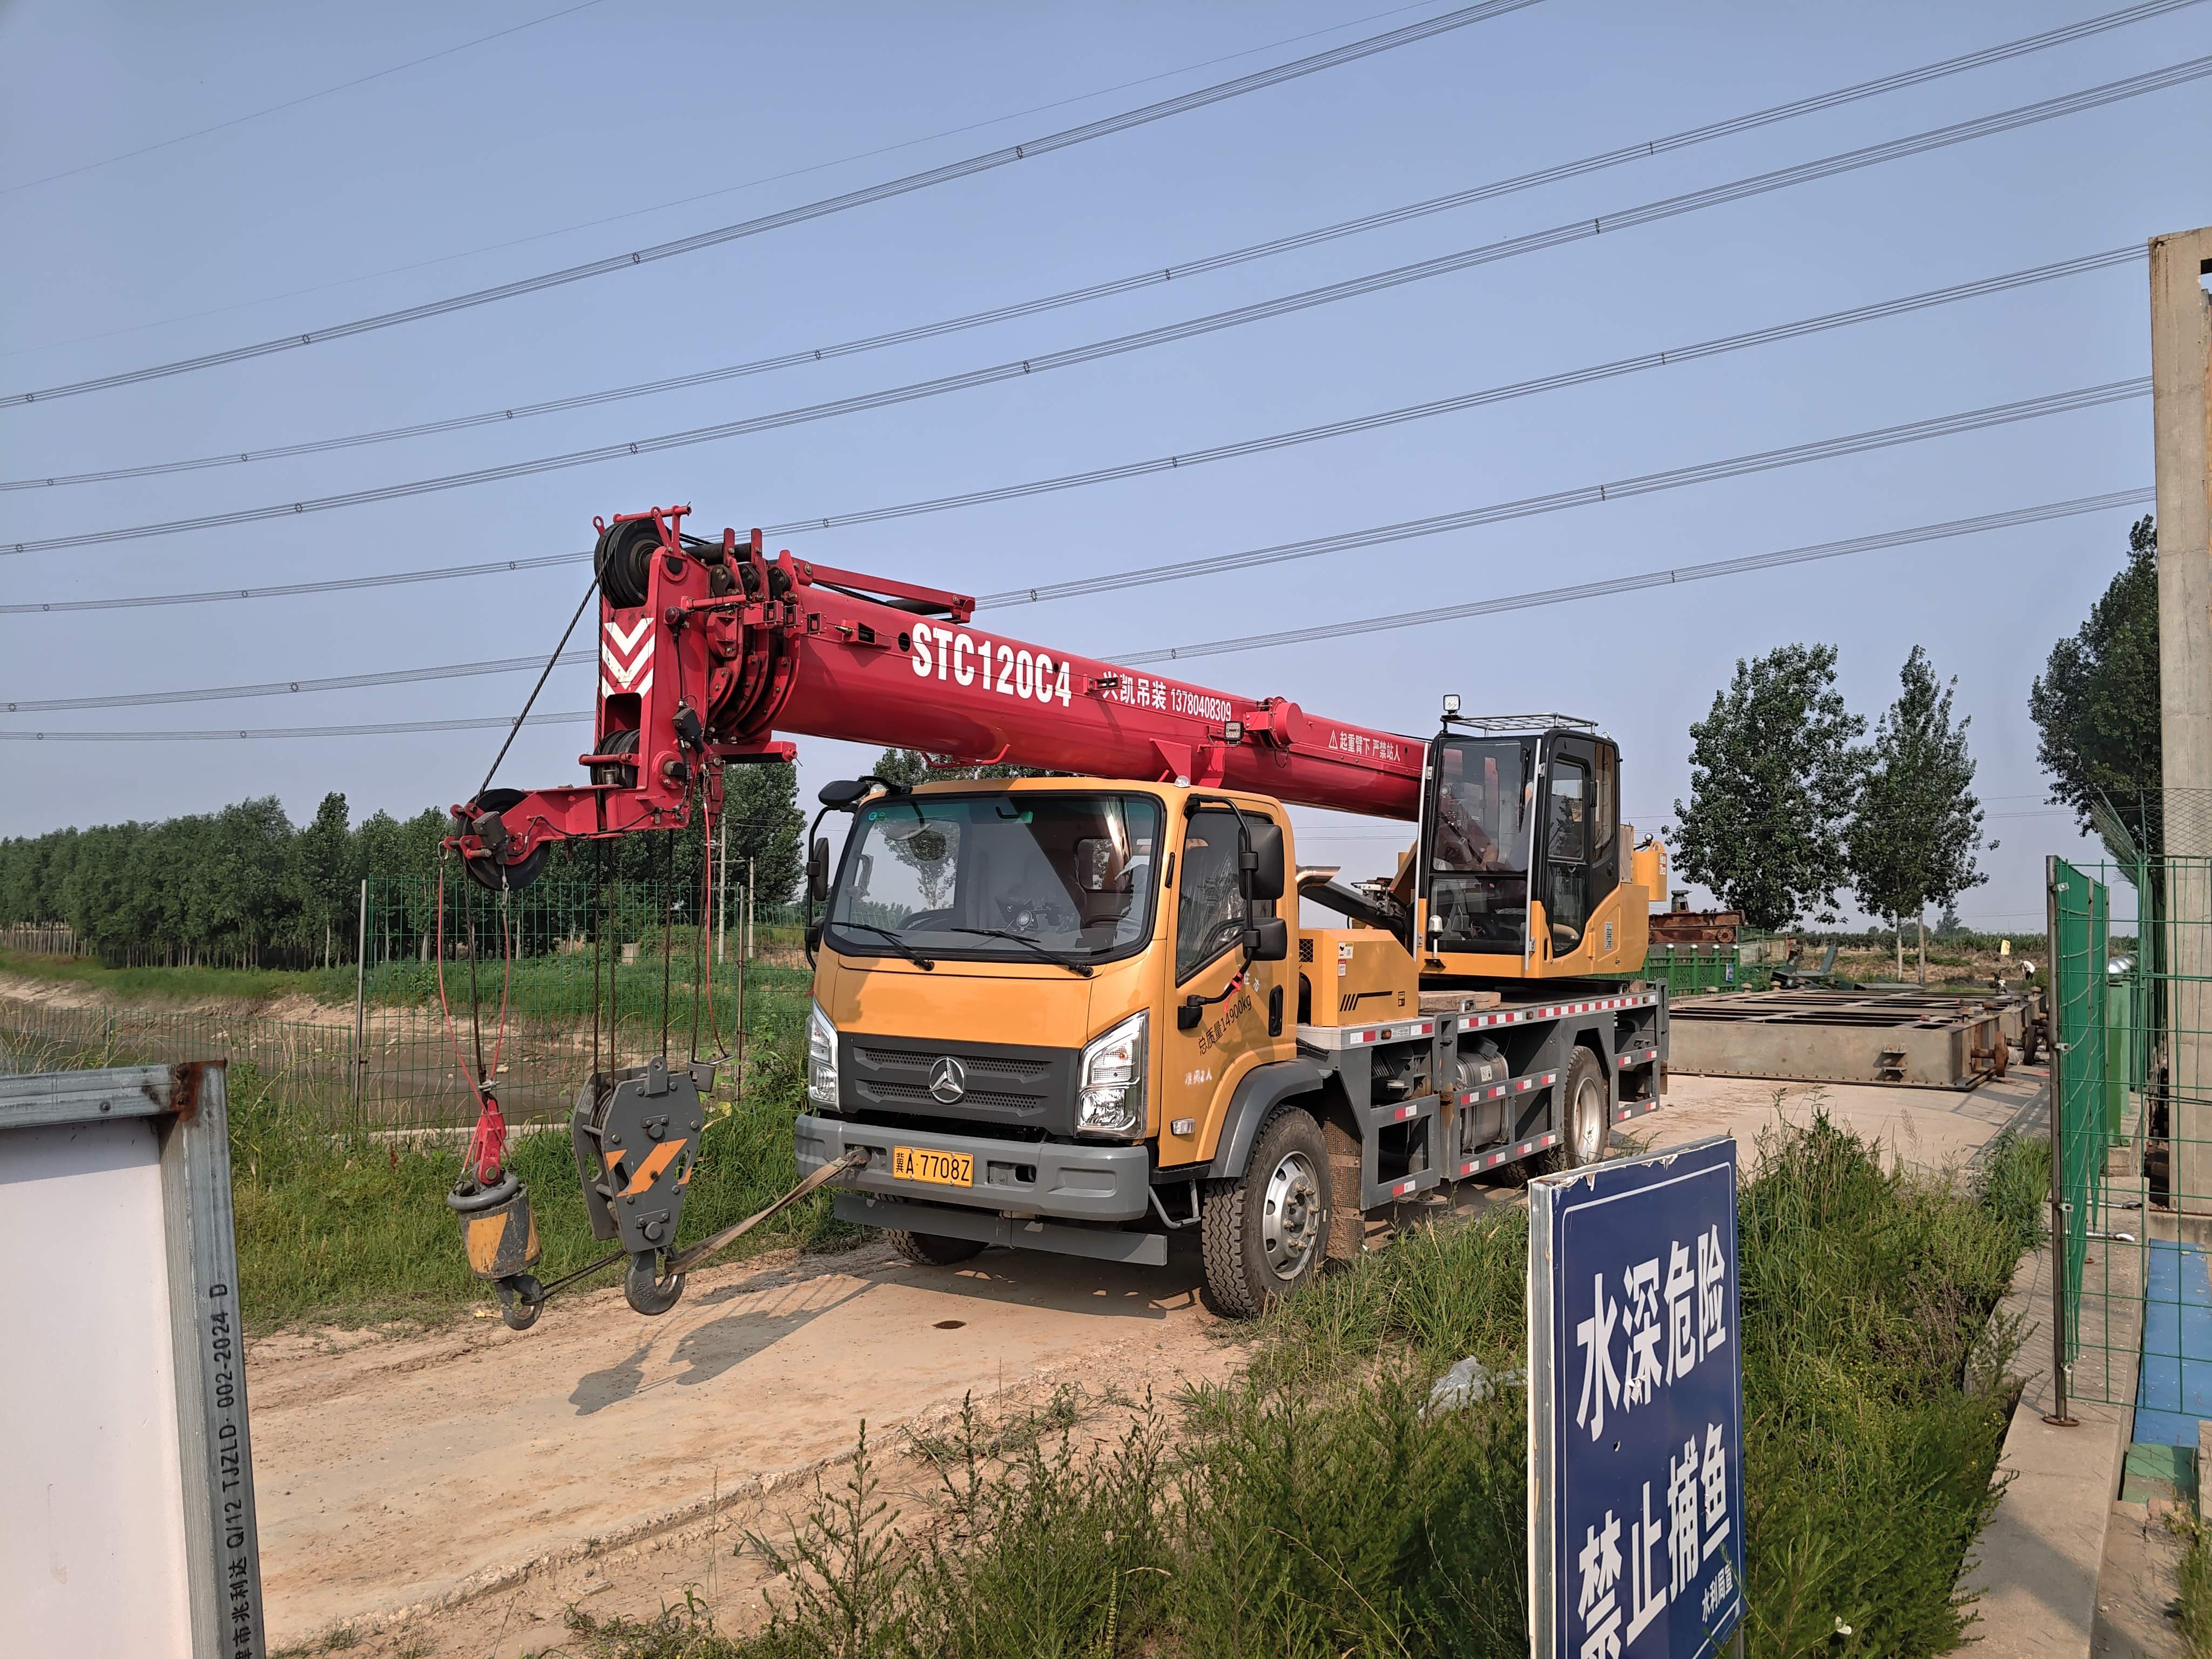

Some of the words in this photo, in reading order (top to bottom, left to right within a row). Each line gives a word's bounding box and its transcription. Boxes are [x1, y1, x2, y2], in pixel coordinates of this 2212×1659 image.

[912, 622, 1071, 707] STC120C4
[1170, 688, 1232, 722] 13780408309
[1340, 731, 1370, 756] 起重臂下
[1372, 739, 1400, 762] 严禁站人
[1198, 995, 1252, 1056] 总质量14900kg
[211, 1310, 234, 1408] 002-2024
[1576, 1224, 1727, 1442] 水深危险
[1577, 1422, 1730, 1659] 禁止捕鱼
